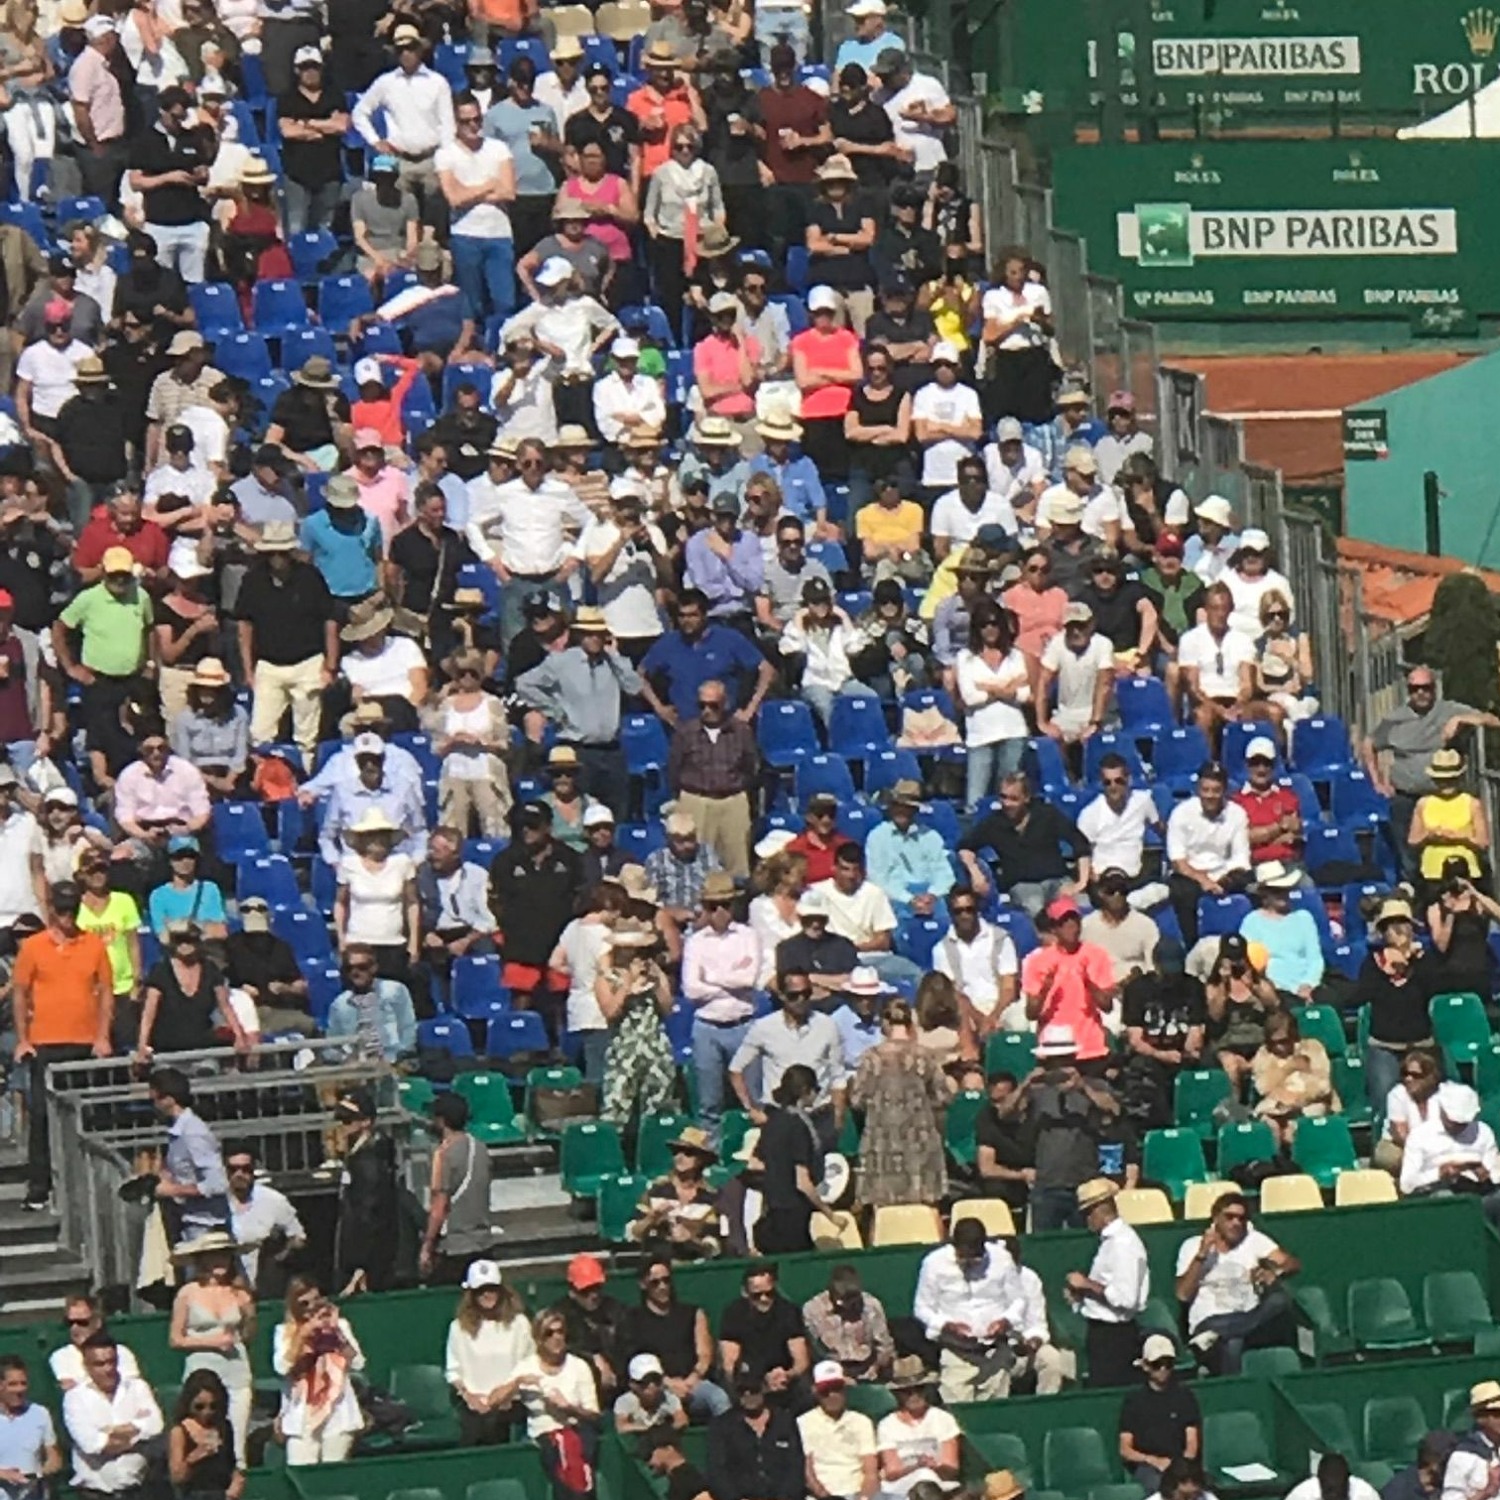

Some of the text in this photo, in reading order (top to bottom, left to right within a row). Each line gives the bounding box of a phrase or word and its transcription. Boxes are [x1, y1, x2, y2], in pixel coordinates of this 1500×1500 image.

[1156, 41, 1346, 70] BNP PARIBAS
[1203, 213, 1440, 250] BNP PARIBAS
